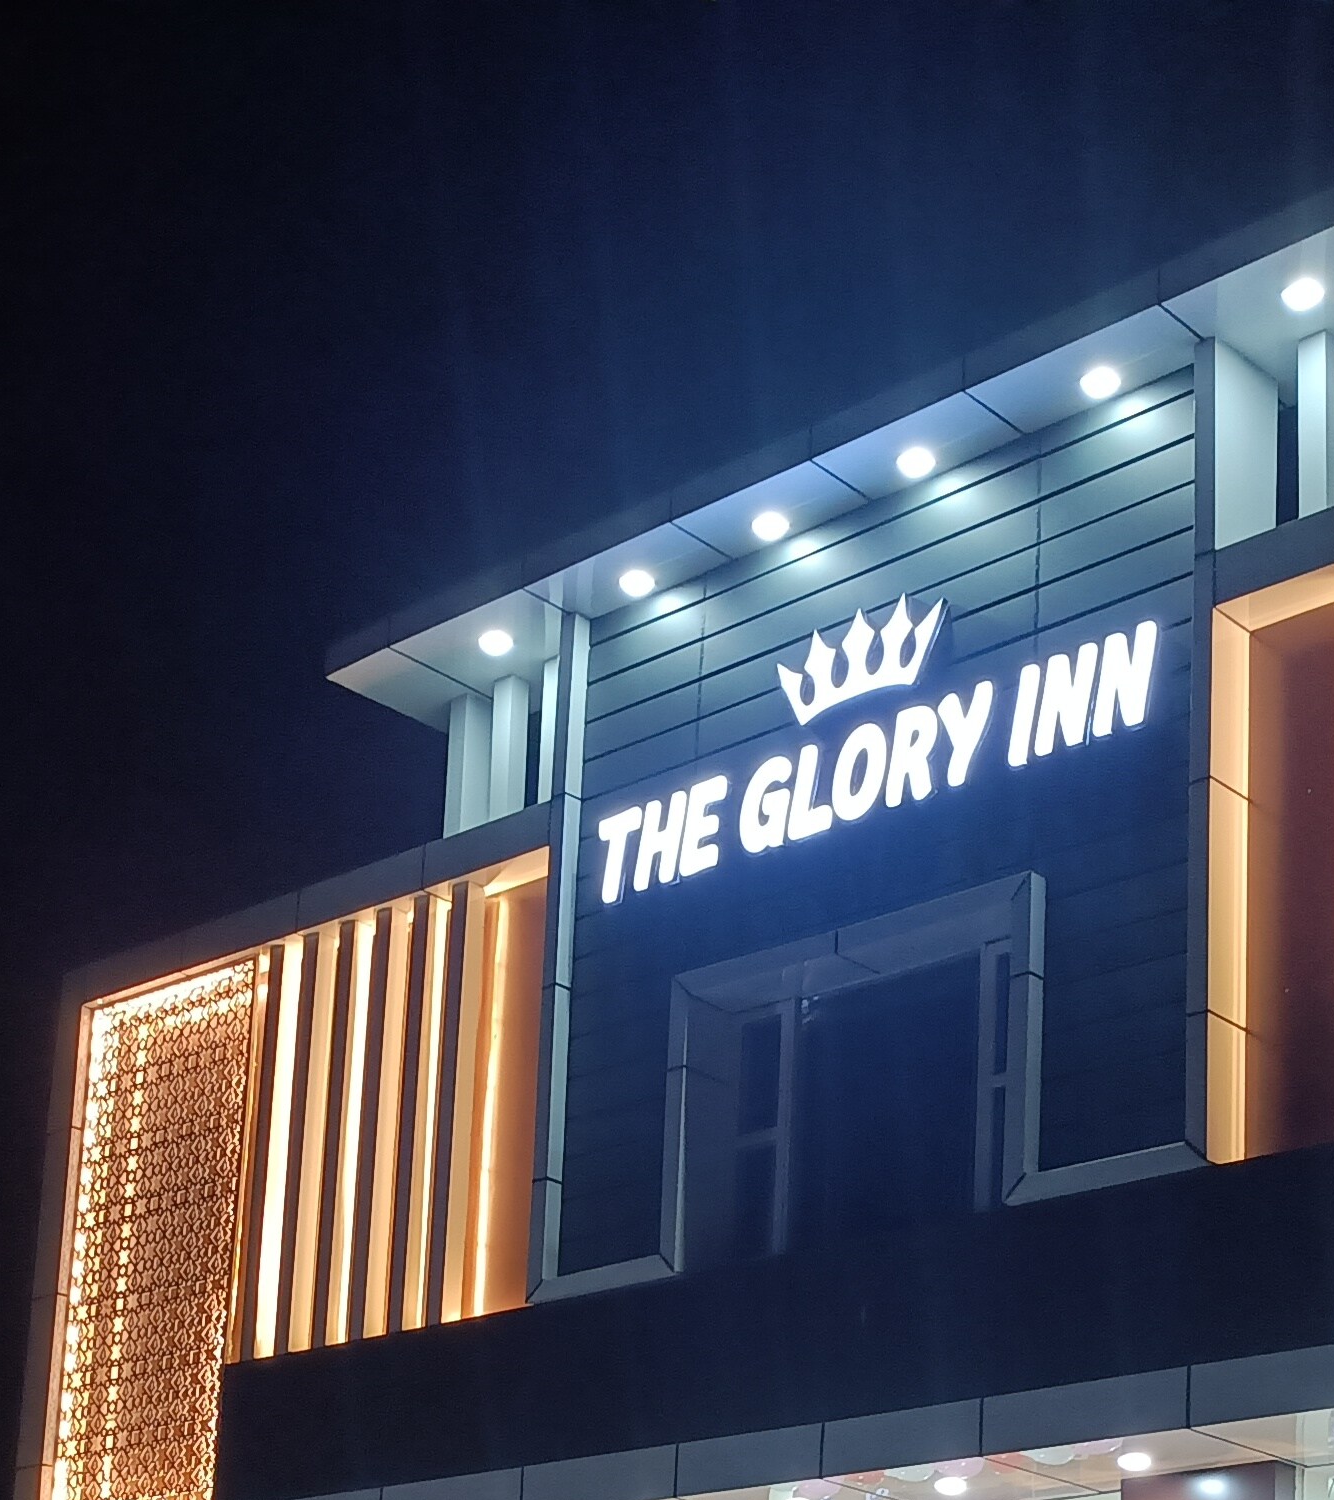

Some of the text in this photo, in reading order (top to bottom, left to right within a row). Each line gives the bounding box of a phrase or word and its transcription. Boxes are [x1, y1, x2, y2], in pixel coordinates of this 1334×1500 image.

[598, 619, 1160, 906] THE GLORY INN
